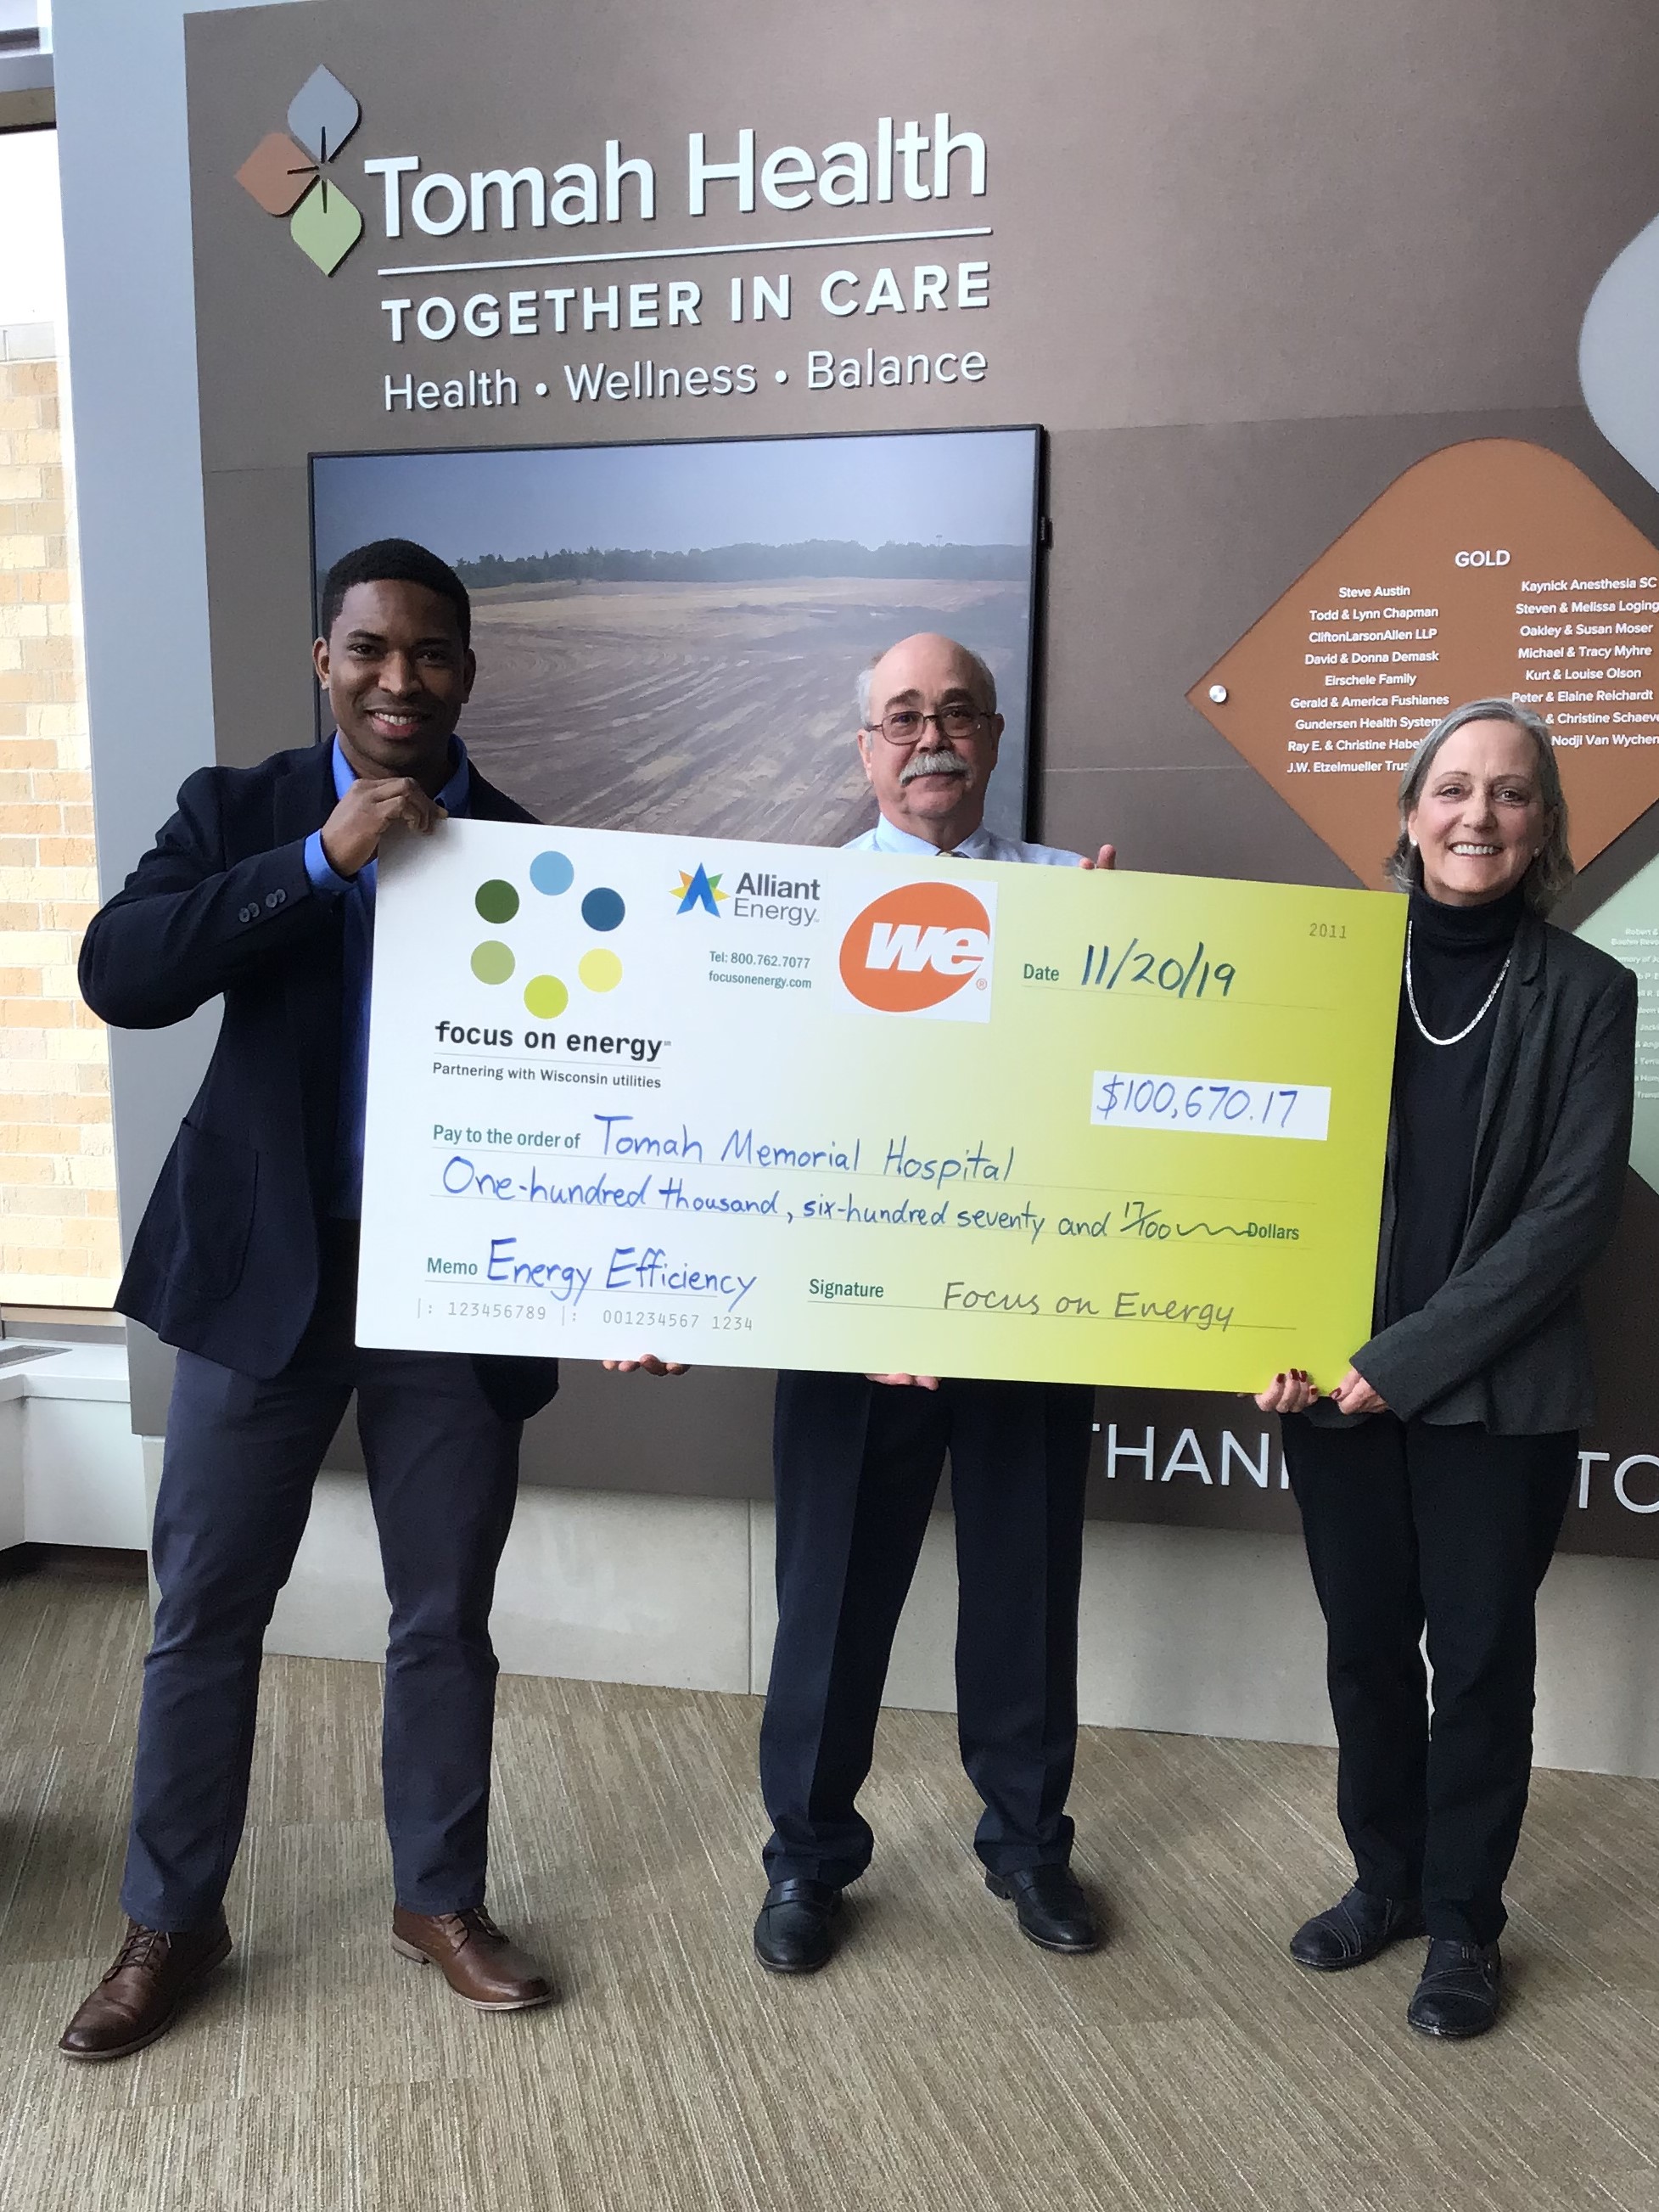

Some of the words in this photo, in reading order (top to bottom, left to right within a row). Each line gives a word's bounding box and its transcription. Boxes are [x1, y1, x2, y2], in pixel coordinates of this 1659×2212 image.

[365, 140, 655, 240] Tomah
[689, 112, 988, 216] Health
[382, 281, 703, 342] TOGETHER
[731, 274, 791, 321] IN
[821, 261, 989, 316] CARE
[384, 368, 517, 411] Health
[564, 360, 758, 404] Wellness
[807, 347, 988, 390] Balance
[1455, 550, 1510, 567] GOLD
[1339, 587, 1371, 598] Steve
[1374, 586, 1410, 597] Austin
[1522, 580, 1567, 594] Kaynick
[1571, 578, 1636, 590] Anesthesia
[1639, 577, 1657, 588] SC
[1309, 609, 1338, 620] Todd
[1342, 609, 1350, 620] &
[1353, 609, 1380, 621] Lynn
[1383, 608, 1438, 620] Chapman
[1516, 604, 1556, 614] Steven
[1560, 603, 1568, 613] &
[1572, 602, 1616, 612] Melissa
[1309, 630, 1412, 643] CliftonLarsonAllen
[1415, 628, 1437, 639] LLP
[1521, 626, 1561, 637] Oakley
[1564, 625, 1572, 635] &
[1576, 624, 1612, 635] Susan
[1616, 623, 1653, 633] Moser
[1305, 652, 1337, 665] David
[1340, 653, 1349, 663] &
[1352, 652, 1389, 663] Donna
[1393, 650, 1439, 662] Demask
[1518, 647, 1564, 659] Michael
[1567, 647, 1575, 657] &
[1578, 647, 1611, 659] Tracy
[1615, 645, 1652, 659] Myhre
[1326, 675, 1376, 686] Eirschele
[1379, 673, 1416, 686] Family
[1526, 670, 1550, 680] Kurt
[1553, 669, 1561, 679] &
[1565, 669, 1603, 679] Louise
[1606, 668, 1641, 678] Olson
[1290, 698, 1327, 708] Gerald
[1331, 697, 1338, 707] &
[1342, 695, 1388, 706] America
[1392, 695, 1449, 705] Fushianes
[1512, 693, 1544, 703] Peter
[1545, 692, 1554, 702] &
[1558, 691, 1594, 702] Elaine
[1596, 689, 1653, 700] Reichardt
[1296, 719, 1357, 730] Gundersen
[1360, 718, 1397, 728] Health
[1545, 714, 1554, 724] &
[1558, 713, 1610, 723] Christine
[1288, 741, 1309, 753] Ray
[1312, 741, 1321, 750] E.
[1325, 741, 1332, 750] &
[1336, 739, 1386, 749] Christine
[1585, 735, 1609, 745] Van
[1287, 763, 1310, 773] J.W.
[1314, 761, 1382, 772] Etzelmueller
[736, 872, 821, 901] Alliant
[734, 898, 817, 926] Energy
[1309, 923, 1347, 939] 2011
[866, 922, 989, 975] we
[710, 951, 727, 963] Tel:
[731, 952, 810, 968] 800.762.7077
[1081, 938, 1236, 998] 11/20/19
[709, 971, 812, 989] focusonenergy.com
[1023, 963, 1059, 981] Date
[435, 1021, 513, 1047] focus
[524, 1030, 556, 1049] on
[567, 1034, 662, 1062] energy
[434, 1063, 503, 1080] Partnering
[508, 1067, 535, 1080] with
[541, 1069, 608, 1085] Wisconsin
[613, 1074, 661, 1088] utilities
[1097, 1074, 1297, 1127] $100,670.17
[433, 1125, 462, 1145] Pay
[466, 1129, 482, 1143] to
[487, 1128, 513, 1145] the
[517, 1131, 561, 1148] order
[564, 1133, 580, 1148] of
[594, 1114, 703, 1163] Tomah
[720, 1129, 860, 1171] Memorial
[883, 1135, 1015, 1190] Hospital
[443, 1156, 653, 1208] One-hundred
[804, 1193, 950, 1227] six-hundred
[957, 1201, 1045, 1245] seventy
[1058, 1211, 1111, 1237] and
[1247, 1222, 1299, 1240] Dollars
[428, 1258, 478, 1275] Memo
[487, 1238, 592, 1305] Energy
[606, 1247, 757, 1312] Efficiency
[810, 1279, 883, 1299] Signature
[944, 1282, 1040, 1315] Focus
[1056, 1297, 1099, 1315] on
[1114, 1292, 1234, 1332] Energy
[448, 1302, 546, 1320] 123456789
[603, 1310, 699, 1328] 001234567
[713, 1316, 753, 1331] 1234
[1092, 1423, 1289, 1490] HAN
